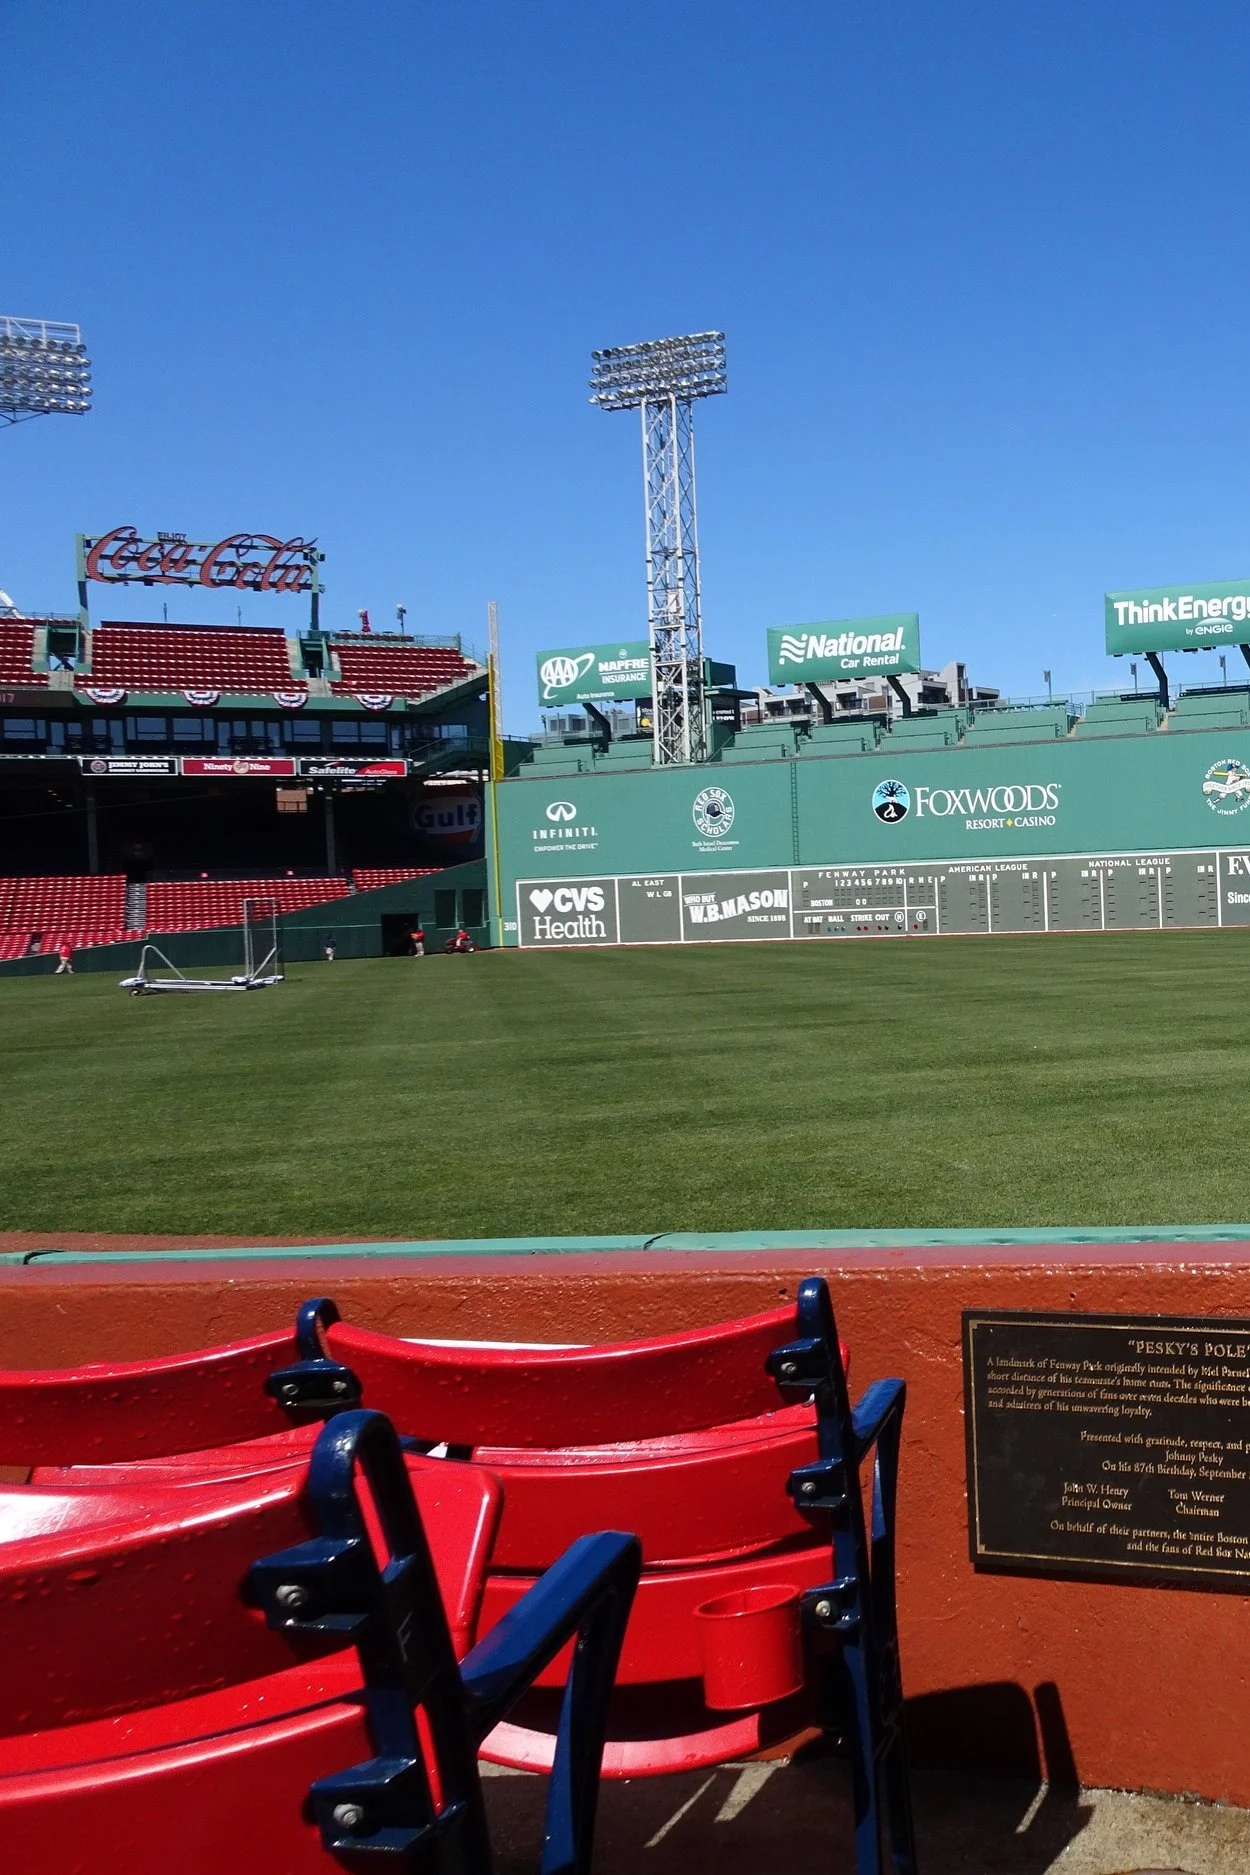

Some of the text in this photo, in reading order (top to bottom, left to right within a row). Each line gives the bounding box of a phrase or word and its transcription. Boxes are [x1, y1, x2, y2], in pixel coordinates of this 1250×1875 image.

[86, 526, 318, 592] Coca-Cola
[1185, 627, 1193, 636] by
[598, 658, 649, 673] MAPFRE
[840, 653, 900, 669] Car Rental
[543, 659, 577, 686] AAA
[602, 672, 647, 684] INSURANCE
[203, 763, 271, 771] Ninety Nine
[308, 766, 357, 774] Safelite
[695, 789, 727, 812] RED SOX
[914, 783, 1059, 817] FOXWOODS
[414, 803, 478, 828] Gulf
[966, 815, 1056, 830] RESORT CASINO
[532, 826, 595, 840] INFINITI
[948, 863, 1028, 873] AMERICAN LEAGUE
[1088, 857, 1170, 868] NATIONAL LEAGUE
[818, 868, 905, 879] FENWAY PARK
[553, 886, 605, 913] CVS
[684, 894, 715, 904] WHO BUT
[810, 899, 833, 907] BOSTON
[747, 915, 769, 923] SINCE
[803, 916, 812, 924] AT
[850, 914, 873, 922] STRIKE
[875, 913, 890, 921] OUT
[503, 921, 517, 931] 310
[533, 914, 607, 940] Health
[1128, 1340, 1198, 1356] "PESKY'S
[987, 1357, 994, 1367] A
[997, 1358, 1035, 1369] landmark
[1037, 1360, 1047, 1369] of
[1050, 1360, 1081, 1374] Fenway
[1083, 1361, 1103, 1372] Park
[1104, 1363, 1145, 1377] originally
[1147, 1364, 1185, 1375] intended
[1188, 1366, 1198, 1380] by
[1201, 1367, 1219, 1377] Mel
[987, 1370, 1009, 1381] short
[1011, 1371, 1045, 1382] distance
[1047, 1373, 1058, 1383] of
[1060, 1374, 1072, 1384] his
[1074, 1374, 1120, 1386] teammate's
[1123, 1377, 1147, 1387] home
[1173, 1379, 1191, 1389] The
[1194, 1380, 1245, 1394] significance
[1080, 1432, 1121, 1443] Presented
[1124, 1434, 1143, 1444] with
[1145, 1436, 1188, 1449] gratitude,
[1190, 1439, 1224, 1452] respect,
[1226, 1440, 1242, 1450] and
[1165, 1450, 1224, 1466] Johnny Pesky
[1102, 1461, 1116, 1471] On
[1118, 1462, 1131, 1472] his
[1134, 1463, 1155, 1473] 87th
[1157, 1464, 1196, 1480] Birthday,
[1199, 1467, 1245, 1481] September
[1063, 1483, 1129, 1500] John W. Henry
[1168, 1489, 1225, 1502] Tom Werner
[1061, 1496, 1132, 1511] Principal Owner
[1175, 1504, 1219, 1516] Chairman
[1050, 1520, 1064, 1531] On
[1066, 1522, 1094, 1533] behalf
[1096, 1524, 1107, 1534] of
[1109, 1525, 1129, 1535] their
[1132, 1527, 1171, 1540] partners,
[1172, 1529, 1186, 1539] the
[1188, 1531, 1215, 1541] entire
[1217, 1532, 1248, 1543] Boston
